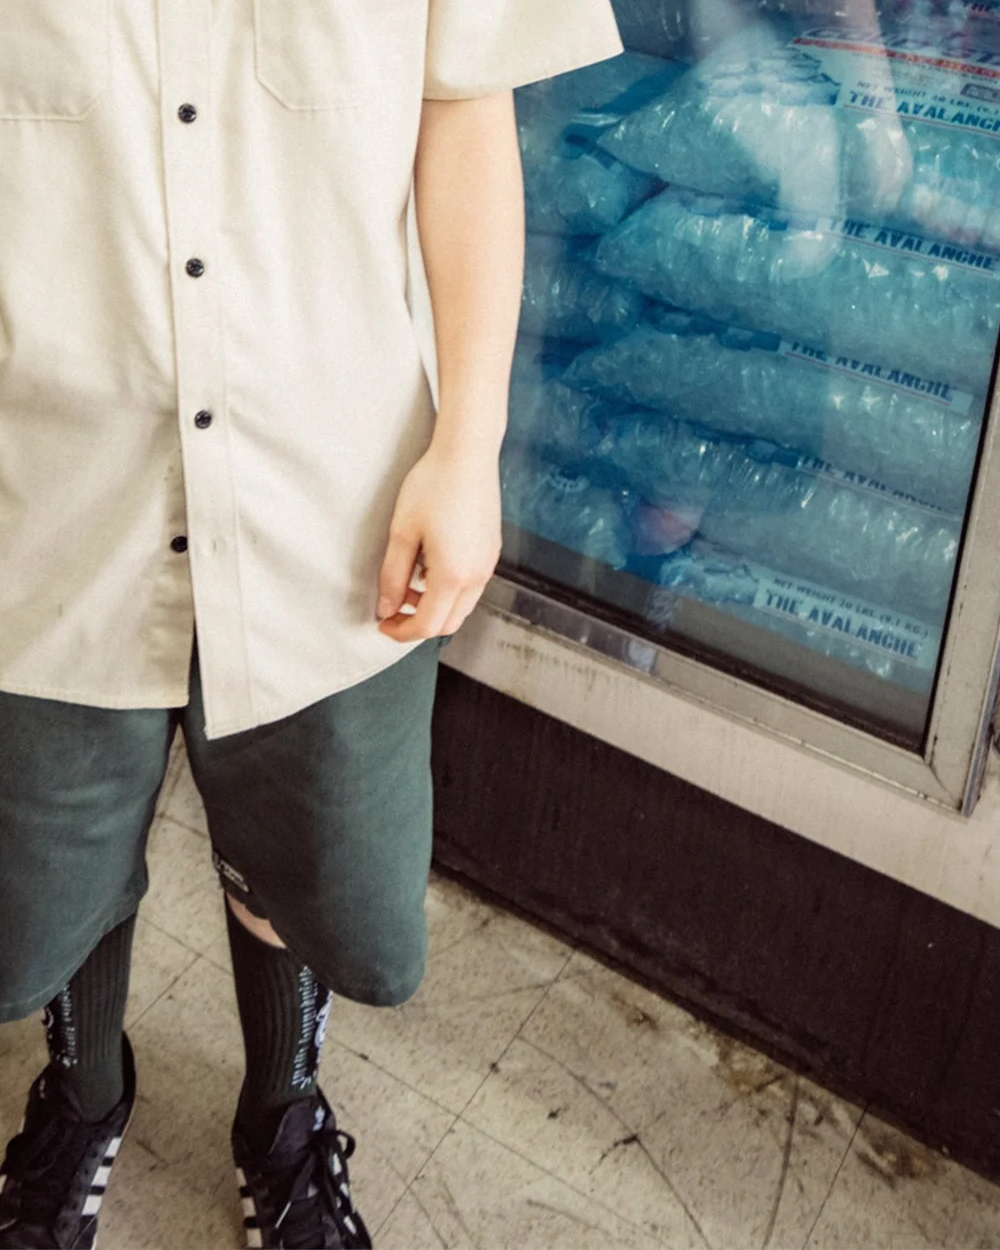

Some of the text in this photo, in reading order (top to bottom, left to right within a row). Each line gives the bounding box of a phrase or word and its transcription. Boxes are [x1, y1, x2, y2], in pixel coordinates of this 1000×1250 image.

[850, 90, 893, 111] THE
[765, 588, 924, 659] THE AVALANCHE
